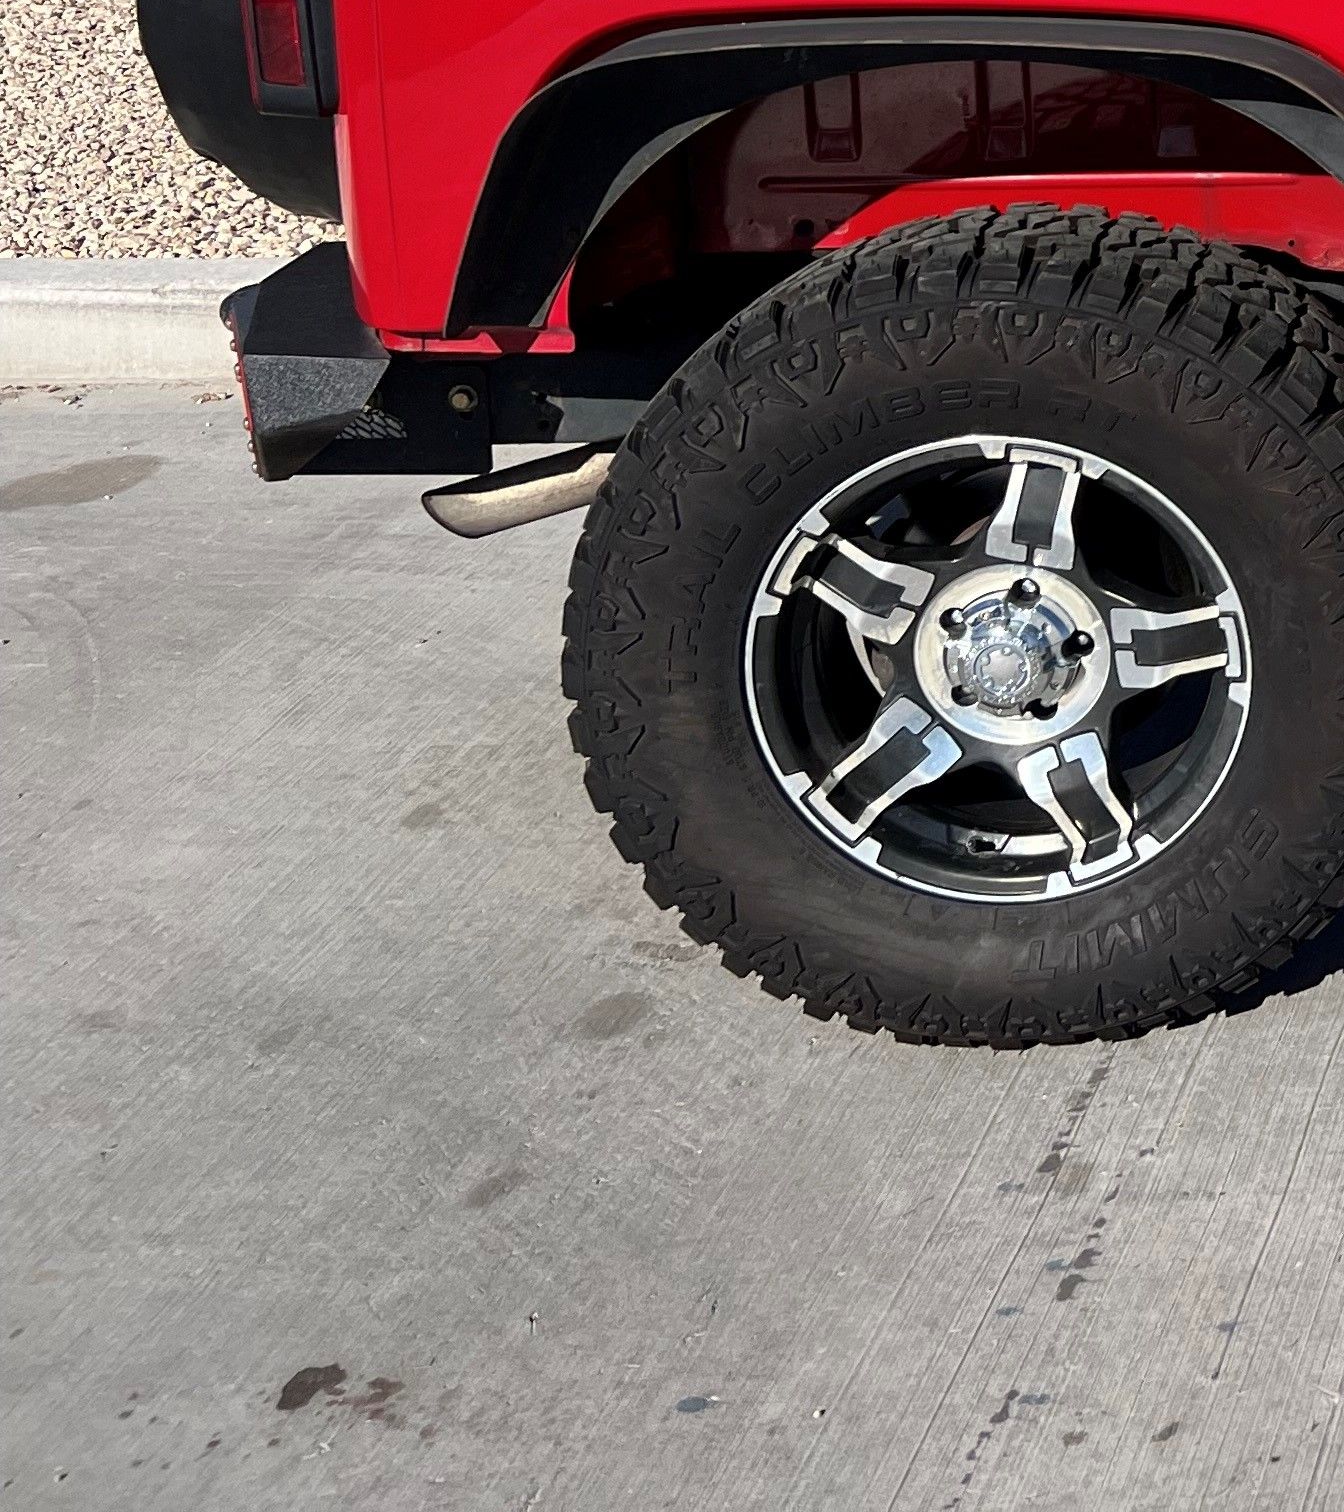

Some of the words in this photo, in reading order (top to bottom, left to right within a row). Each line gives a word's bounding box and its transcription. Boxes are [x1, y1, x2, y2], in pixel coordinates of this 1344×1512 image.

[664, 520, 742, 696] TRAIL
[737, 377, 1023, 507] CLIMBER
[1007, 807, 1279, 982] SUMMIT
